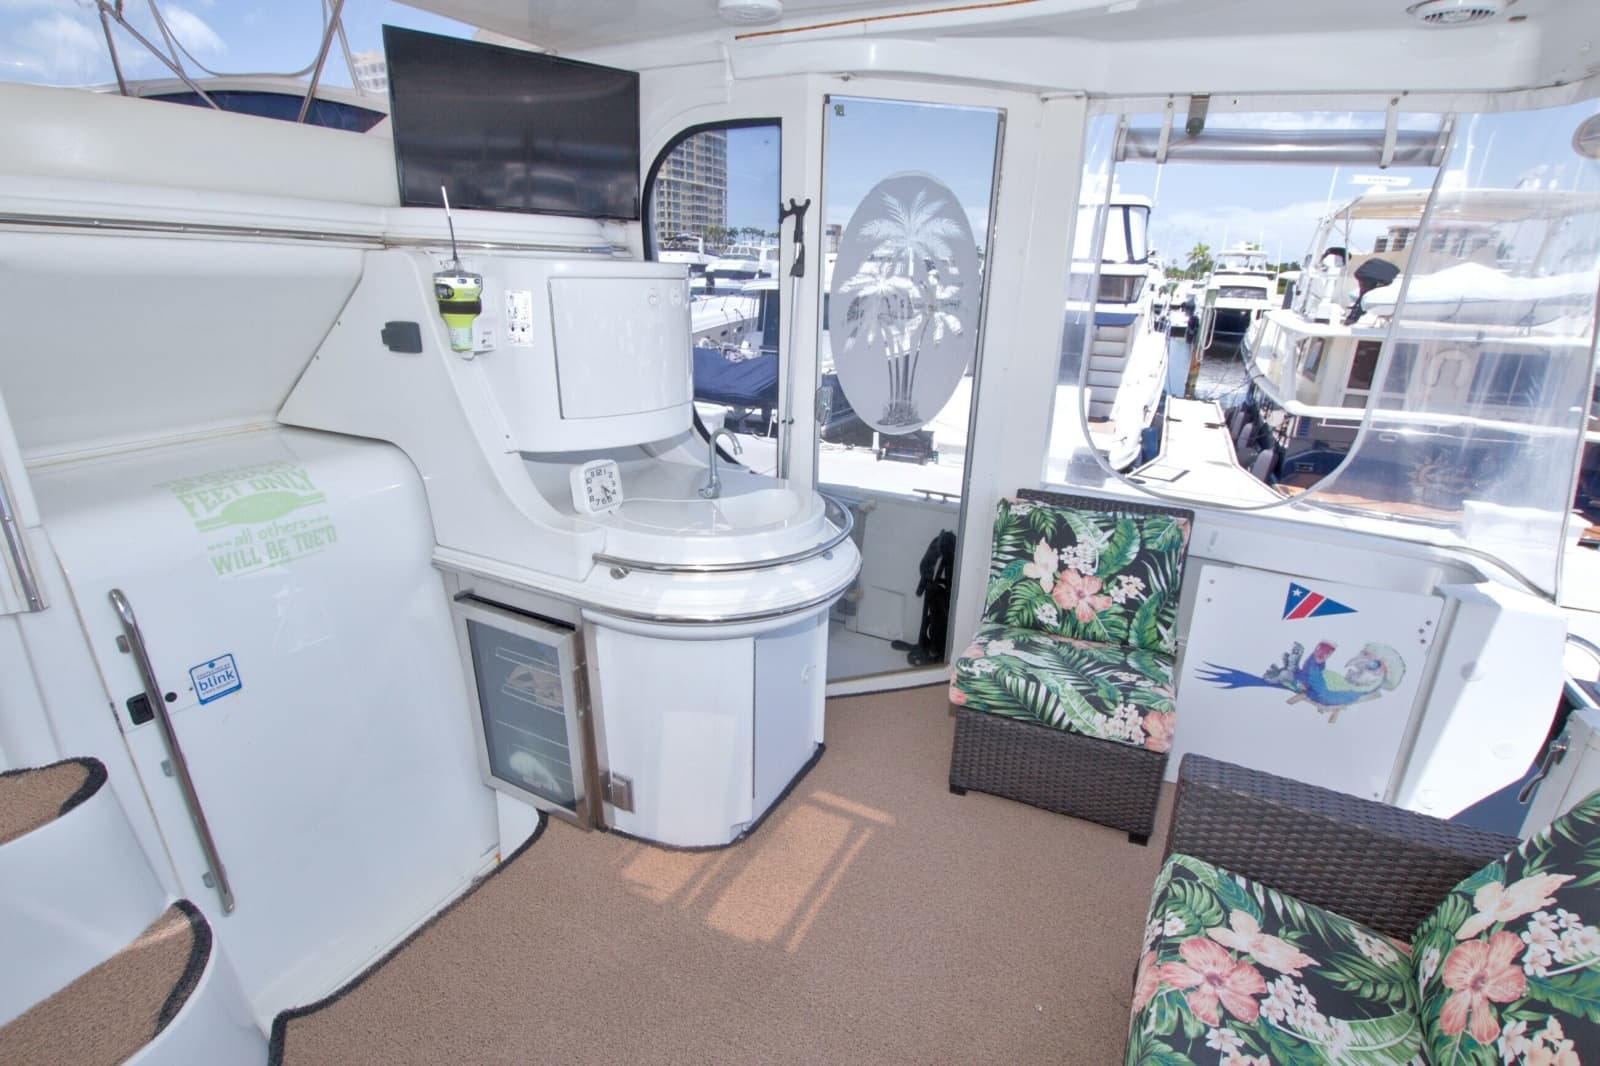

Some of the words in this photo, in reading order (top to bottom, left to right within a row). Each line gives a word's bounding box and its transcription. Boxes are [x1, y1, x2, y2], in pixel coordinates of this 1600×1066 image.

[176, 482, 240, 517] FEET
[233, 527, 253, 546] all
[210, 546, 262, 576] WILL
[265, 538, 289, 560] BE
[198, 670, 235, 691] blink
